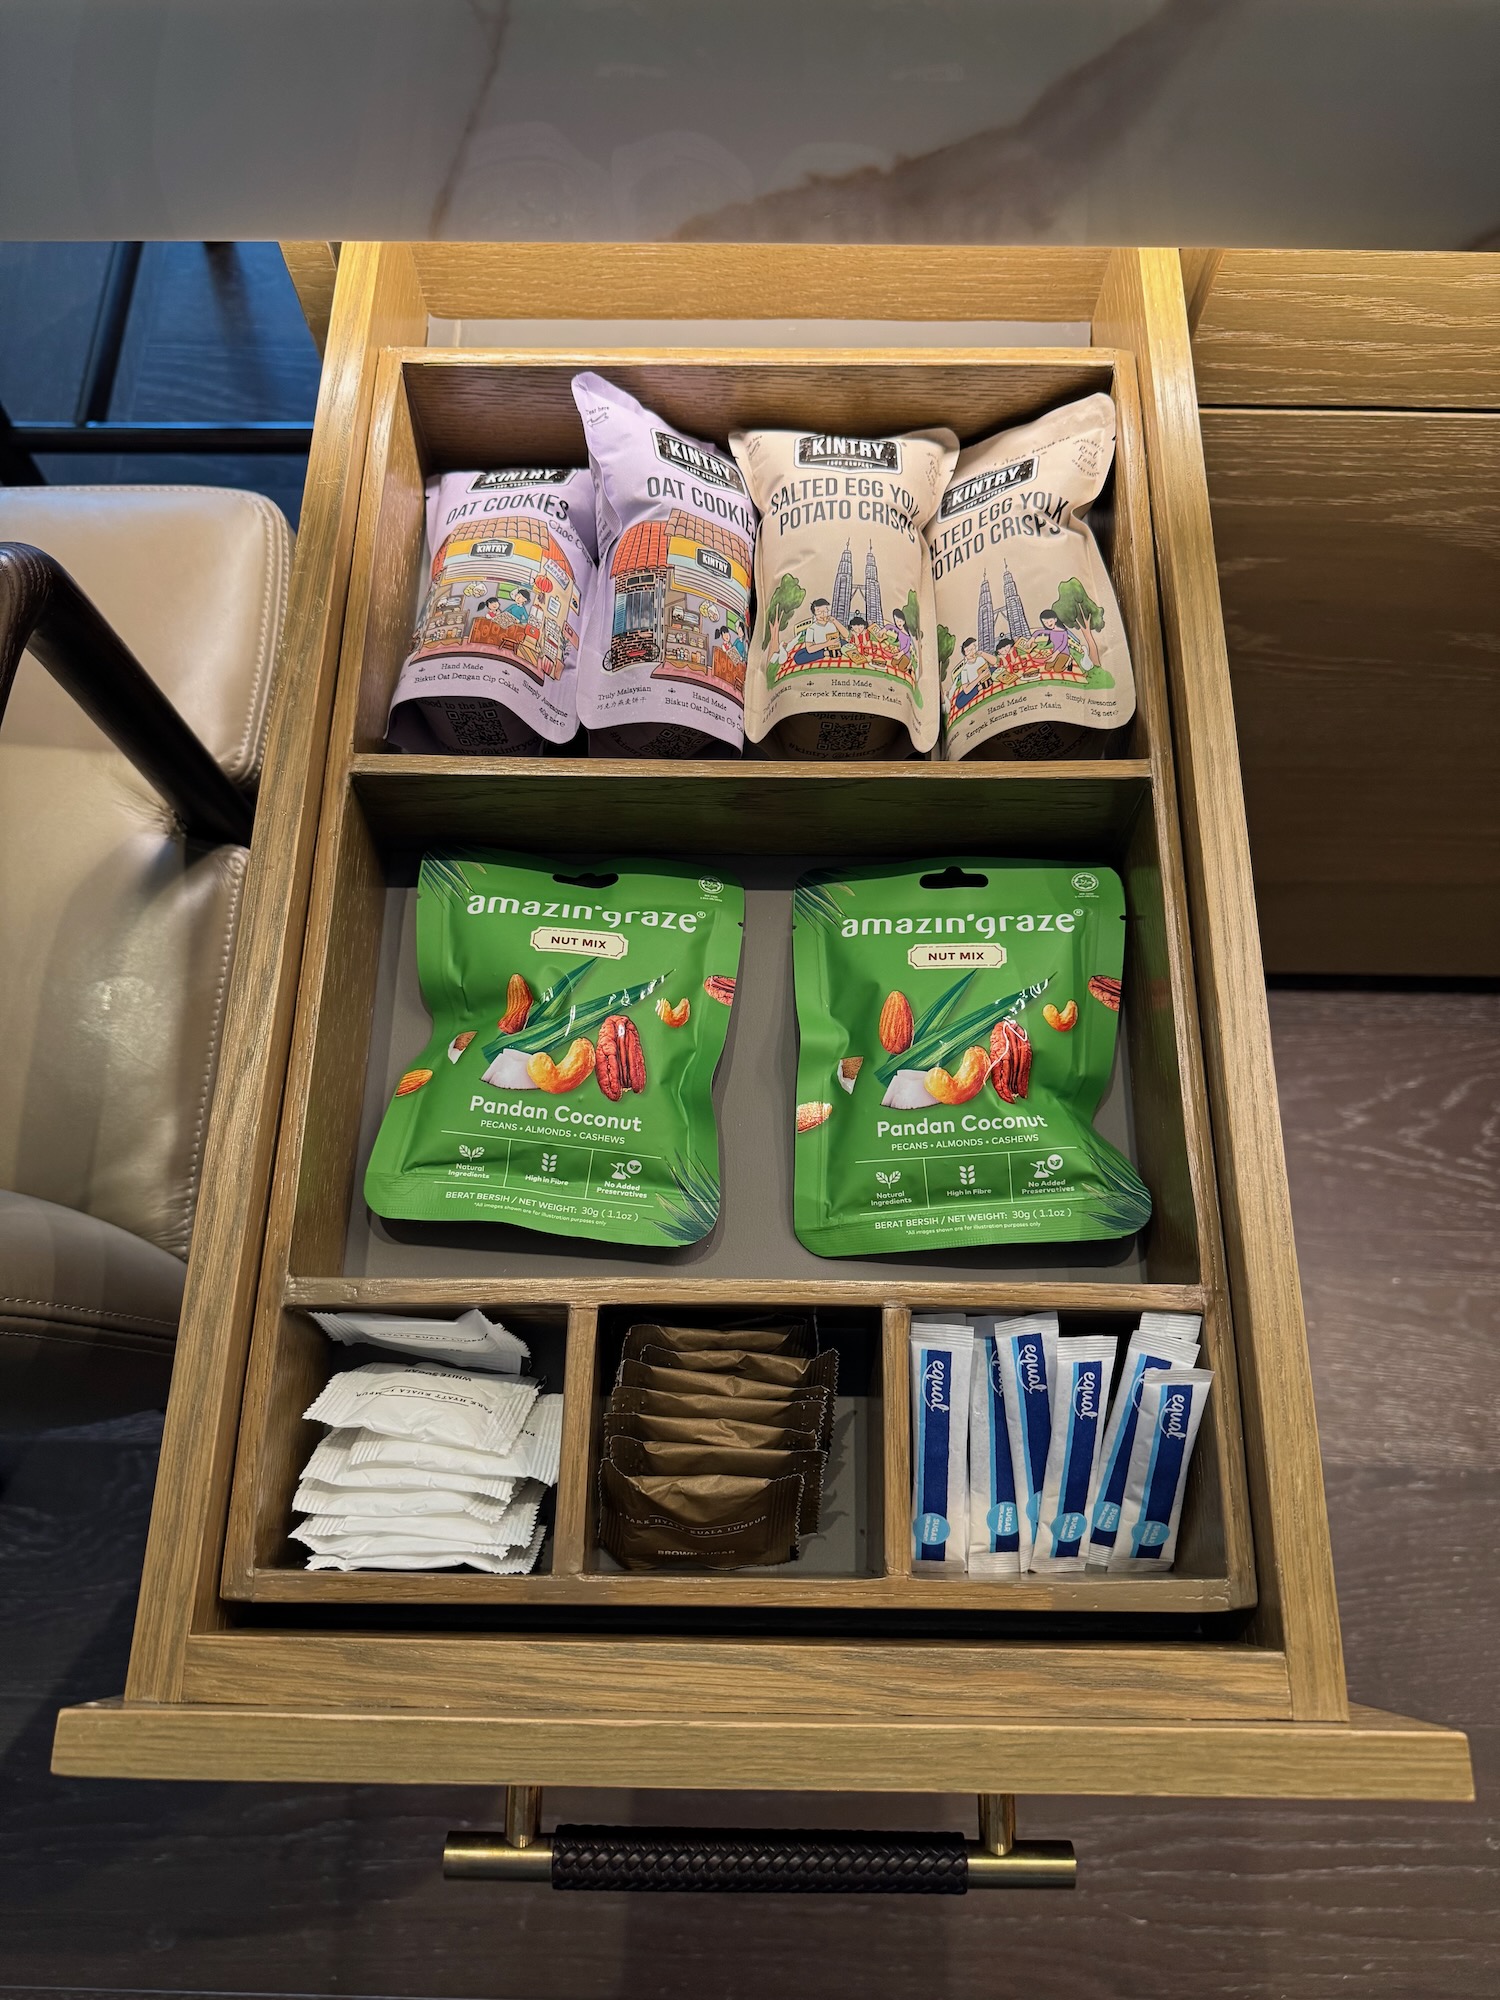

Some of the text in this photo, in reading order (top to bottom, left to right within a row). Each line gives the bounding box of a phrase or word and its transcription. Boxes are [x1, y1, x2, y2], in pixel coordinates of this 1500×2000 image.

[812, 435, 885, 460] KINTRY
[669, 438, 731, 481] KINTRY
[647, 476, 685, 501] OAT
[770, 477, 838, 516] SALTED
[846, 477, 884, 498] EGG
[952, 466, 1020, 506] KINTRY
[446, 492, 570, 525] OAT COOKIES
[978, 498, 1012, 530] EGG
[1020, 492, 1068, 525] YOLK
[549, 519, 574, 542] Choc
[780, 500, 917, 544] POTATO CRISPS
[476, 544, 508, 554] KINTRY
[932, 514, 1061, 581] OTATO CRISPS
[702, 554, 728, 573] KINTRY
[441, 663, 484, 671] Hand Made
[414, 674, 436, 684] Biskut
[437, 673, 450, 681] Oat
[452, 672, 480, 682] Dengan
[482, 674, 496, 684] Cip
[498, 678, 520, 694] Coklat
[522, 680, 541, 701] Simply
[617, 685, 652, 698] Malaysian
[831, 679, 872, 688] Hand Made
[692, 691, 728, 712] Hand Made
[800, 691, 830, 699] Kerepek
[832, 691, 862, 699] Kentang
[987, 695, 1027, 715] Hand Made
[1066, 692, 1117, 707] Simply Awesome
[665, 697, 689, 708] Biskut
[690, 702, 702, 712] Oat
[704, 708, 726, 722] Dengan
[990, 709, 1018, 726] Kentang
[1040, 702, 1062, 710] Masin
[551, 935, 606, 949] NUT MIX
[928, 952, 984, 961] NUT MIX
[470, 1095, 642, 1132] Pandan Coconut
[480, 1120, 626, 1145] PECANS ALMONDS CASHEWS
[877, 1114, 1048, 1138] Pandan Coconut
[891, 1134, 1039, 1151] PECANS ALMONDS CASHEWS
[448, 1169, 490, 1180] Ingredients
[456, 1162, 485, 1172] Natural
[524, 1173, 569, 1186] High in Fibre
[604, 1180, 640, 1191] No Added
[1022, 1185, 1075, 1195] Preservatives
[1028, 1179, 1066, 1188] No Added
[596, 1187, 648, 1199] Preservatives
[870, 1197, 912, 1206] Ingredients
[876, 1190, 905, 1200] Natural
[946, 1187, 992, 1198] High in Fibre
[445, 1191, 475, 1200] BERAT
[476, 1192, 510, 1202] BERSIH
[518, 1197, 537, 1207] NET
[538, 1201, 578, 1214] WEIGHT:
[581, 1207, 600, 1218] 30g
[504, 1204, 522, 1212] shown
[541, 1211, 570, 1221] illustration
[570, 1216, 594, 1225] purposes
[875, 1220, 904, 1230] BERAT
[906, 1218, 939, 1228] BERSIH
[948, 1214, 966, 1224] NET
[967, 1212, 1008, 1222] WEIGHT:
[1012, 1210, 1031, 1220] 30g
[916, 1228, 936, 1236] images
[1004, 1222, 1029, 1230] purposes
[1030, 1220, 1041, 1228] only
[1019, 1344, 1047, 1394] equal
[926, 1360, 950, 1412] equal
[1077, 1371, 1098, 1420] equal
[434, 1394, 467, 1404] HYATT
[1165, 1394, 1186, 1439] equal
[728, 1515, 768, 1532] LUMPUR
[1004, 1506, 1013, 1532] SUGAR
[1068, 1516, 1078, 1538] SUGAR
[1104, 1508, 1118, 1529] SUGAR
[930, 1518, 940, 1542] SUGAR
